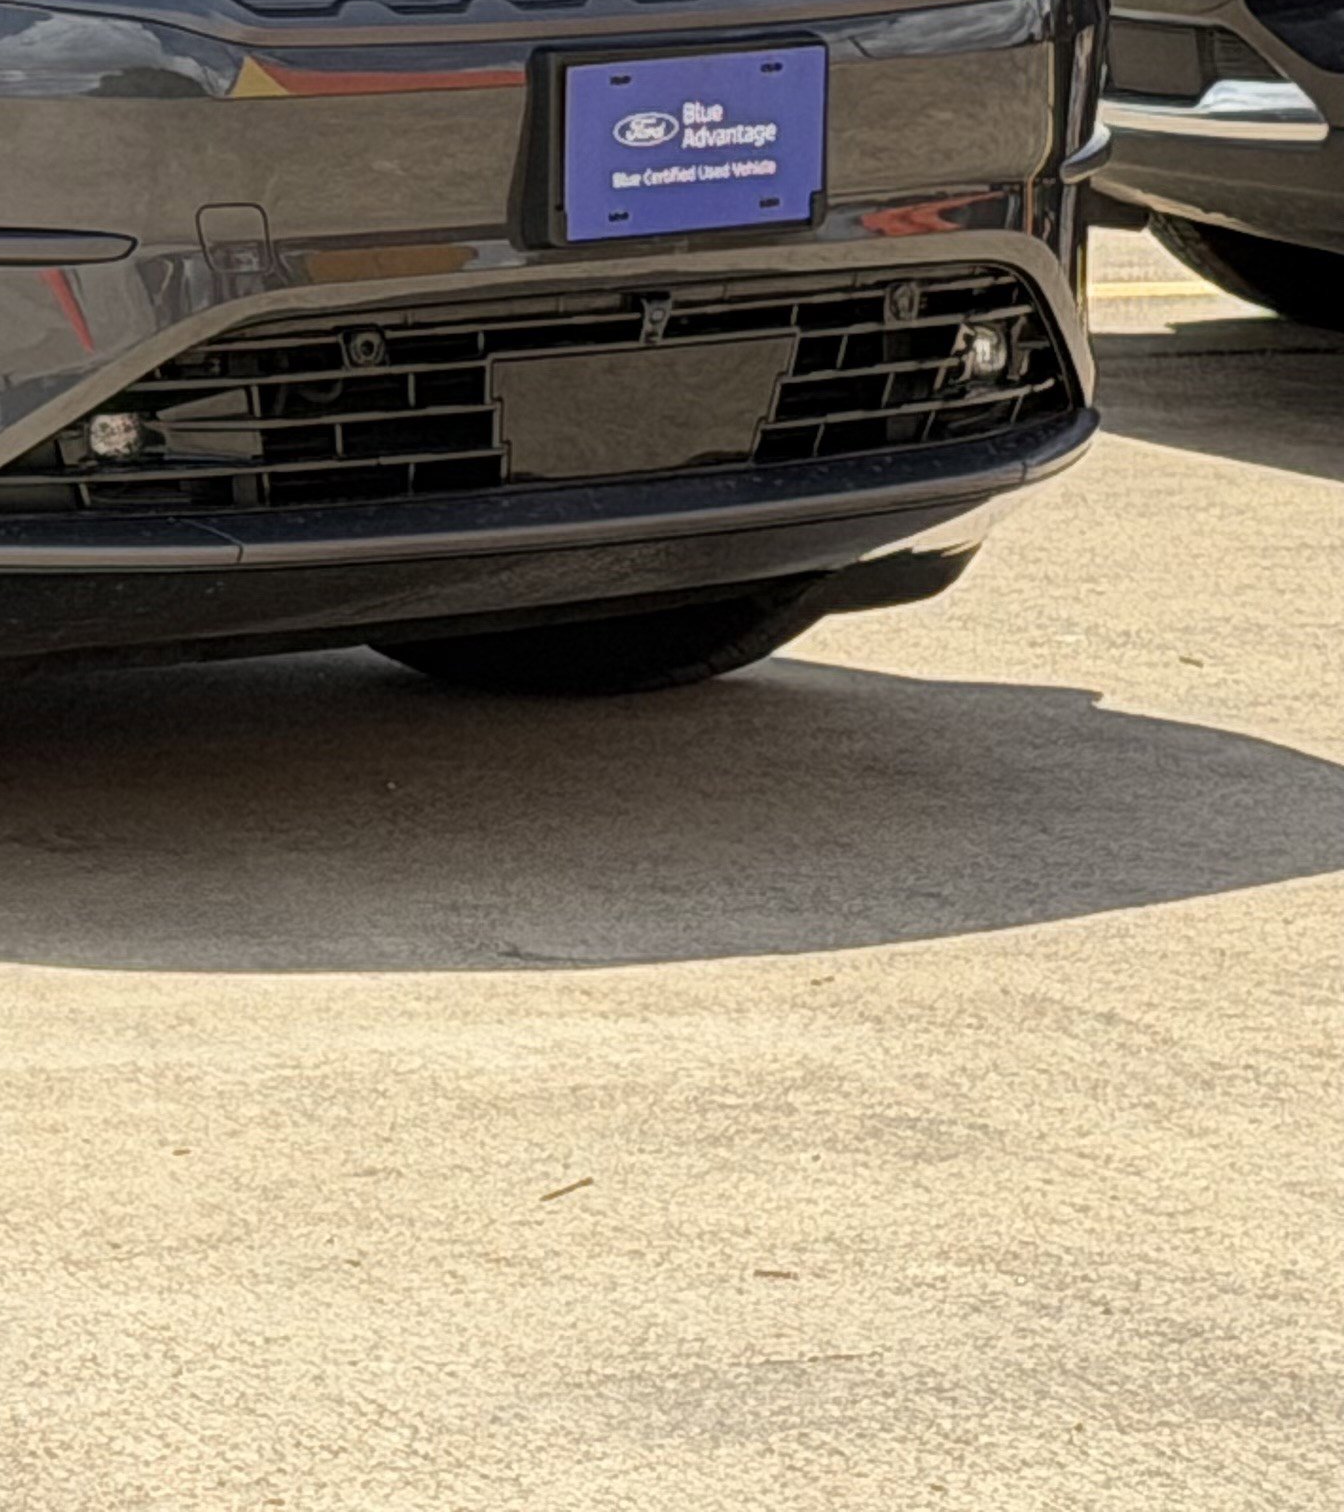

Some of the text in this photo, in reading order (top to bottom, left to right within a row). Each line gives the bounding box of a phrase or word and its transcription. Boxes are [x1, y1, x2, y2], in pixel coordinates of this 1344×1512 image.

[682, 101, 724, 126] Blue
[681, 122, 778, 150] Advantage
[643, 164, 696, 186] Certified
[698, 161, 730, 181] Used
[732, 159, 777, 178] Vehicle
